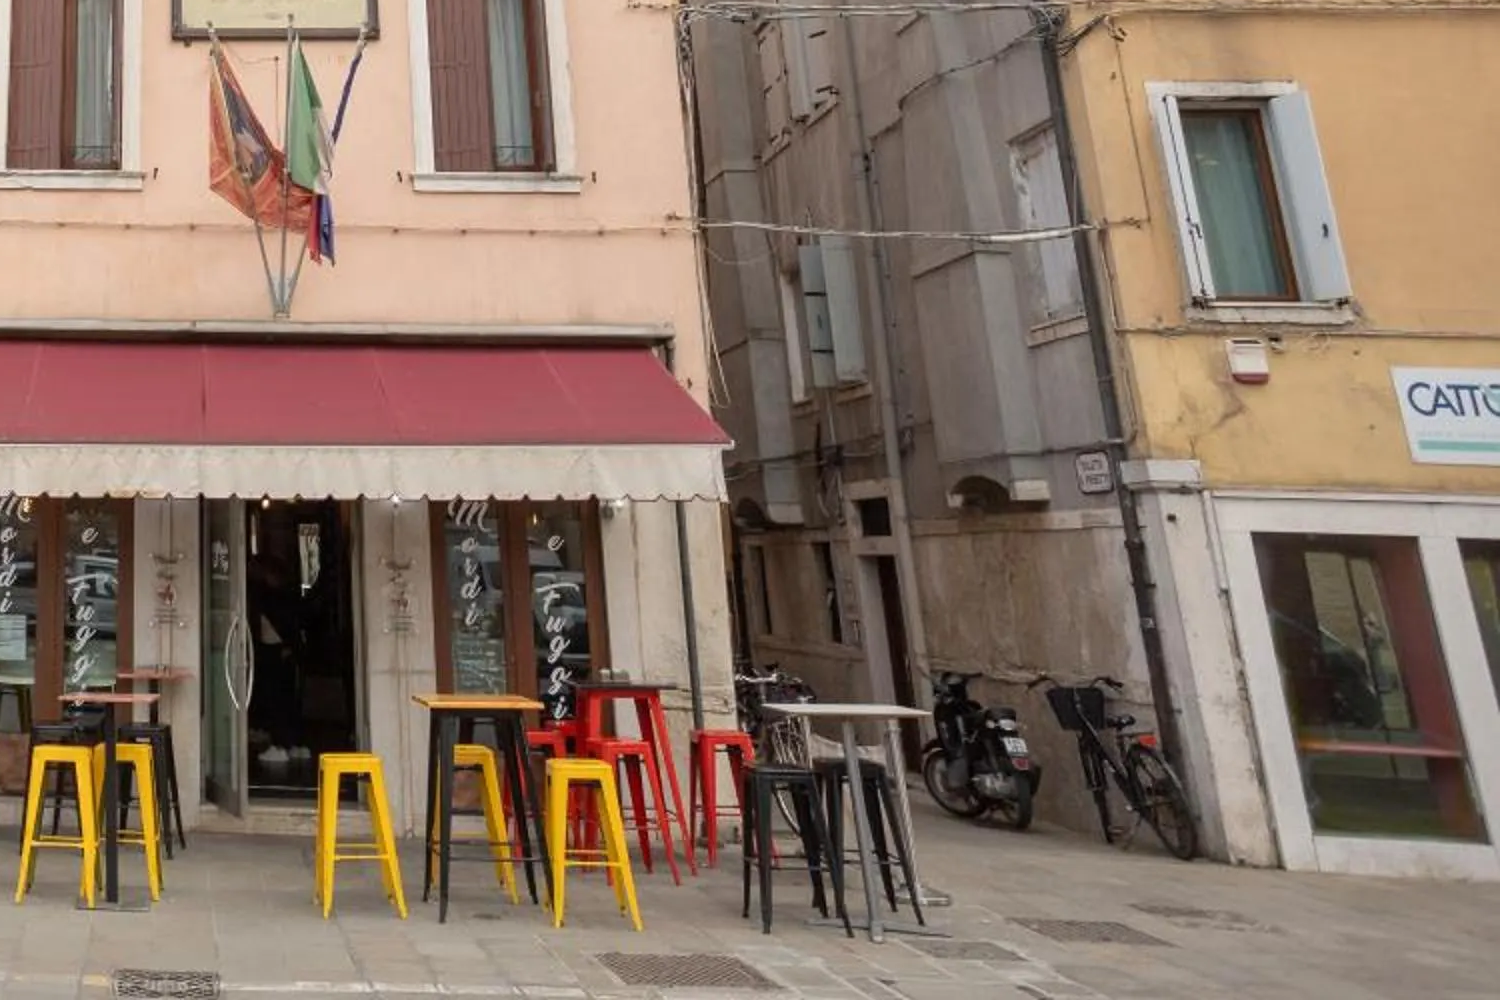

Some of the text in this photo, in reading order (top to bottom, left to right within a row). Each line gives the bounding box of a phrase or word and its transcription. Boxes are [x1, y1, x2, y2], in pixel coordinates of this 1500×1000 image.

[448, 501, 492, 626] Mordi
[548, 535, 564, 551] e
[536, 583, 580, 719] Fuggi
